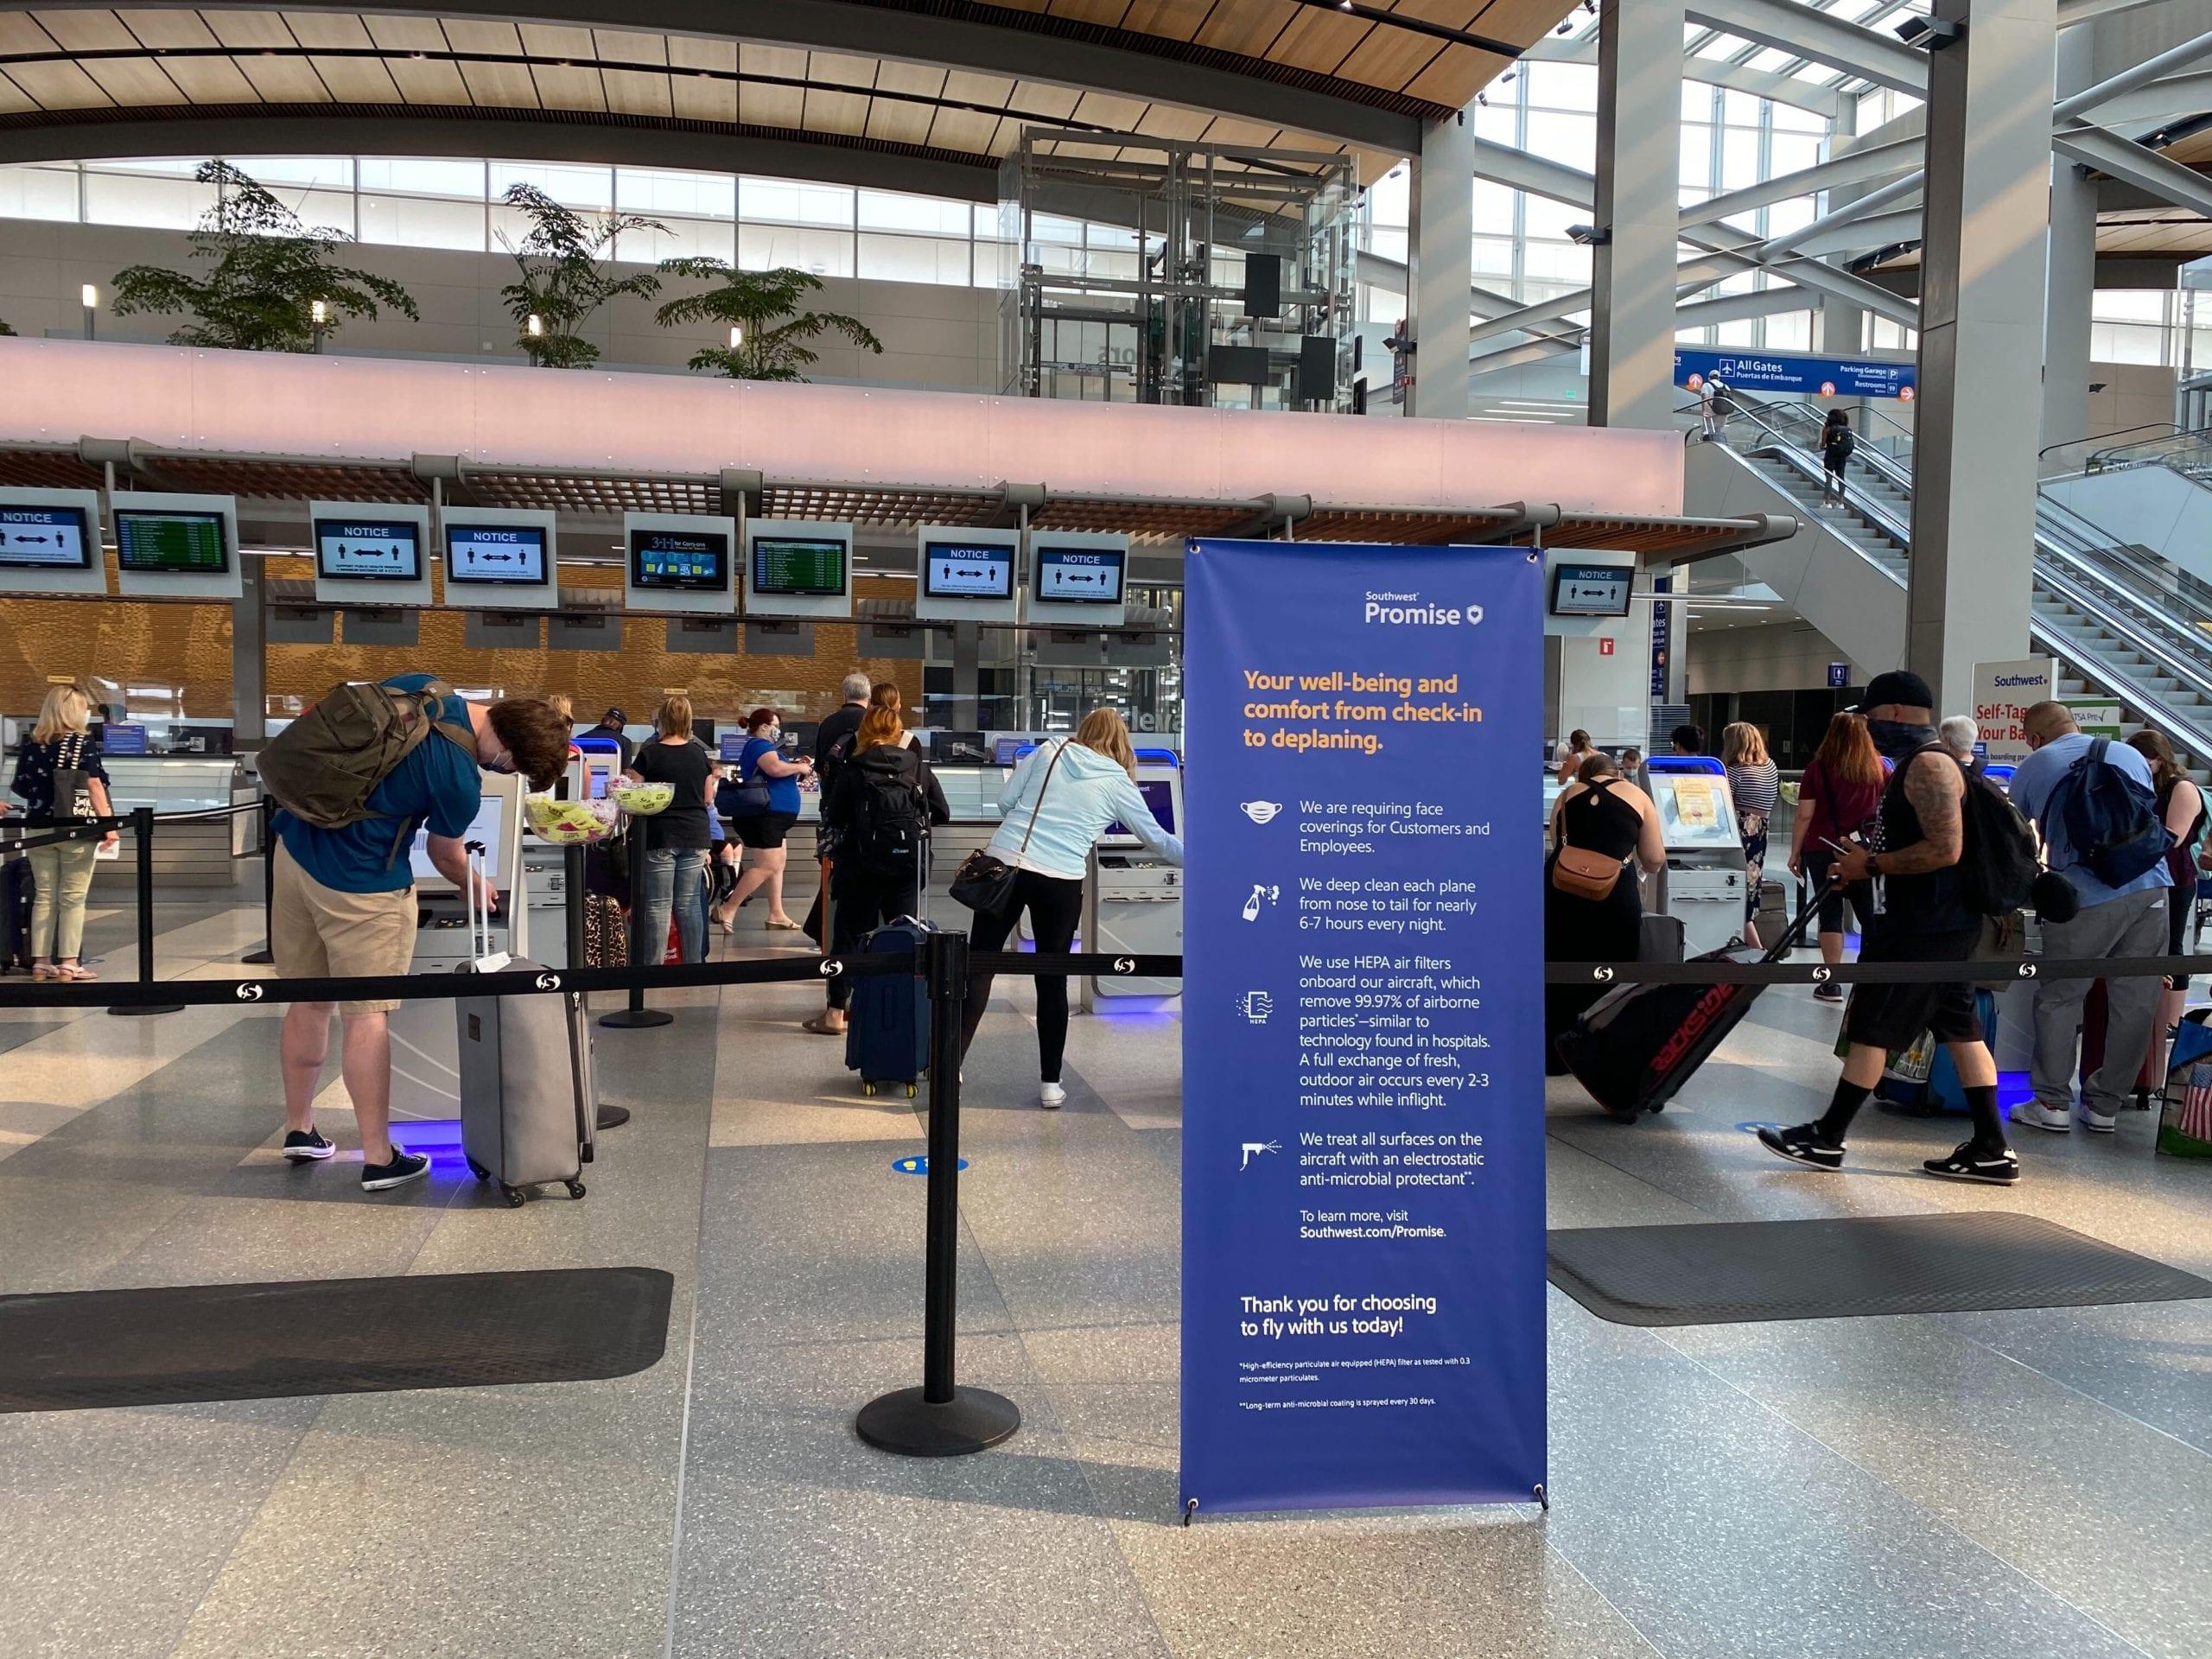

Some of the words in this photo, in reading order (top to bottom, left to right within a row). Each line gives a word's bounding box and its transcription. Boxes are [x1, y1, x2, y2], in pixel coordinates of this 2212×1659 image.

[1737, 360, 1751, 371] All
[1753, 361, 1783, 372] Gates
[1840, 365, 1864, 375] Parking
[1865, 366, 1887, 376] Garage
[1736, 372, 1761, 380] Puertas
[1770, 373, 1803, 383] Embarque
[3, 512, 53, 524] NOTICE
[344, 527, 390, 537] NOTICE
[474, 532, 518, 543] NOTICE
[950, 550, 989, 560] NOTICE
[1063, 555, 1101, 564] NOTICE
[1579, 571, 1613, 580] NOTICE
[1366, 602, 1460, 625] Promise
[1652, 618, 1666, 628] ates
[1244, 671, 1294, 690] Your
[1299, 672, 1411, 698] well-being
[1418, 674, 1457, 693] and
[1994, 674, 2044, 687] Southwest
[1244, 699, 1330, 719] comfort
[1335, 701, 1386, 720] from
[1392, 702, 1482, 721] check-in
[2074, 713, 2086, 721] TSA
[1977, 725, 2005, 741] Your
[2009, 725, 2026, 741] Ba
[1243, 729, 1266, 747] to
[1272, 728, 1382, 754] deplaning.
[1990, 753, 2017, 762] boarding
[1300, 801, 1322, 813] We
[1326, 804, 1347, 813] are
[1352, 802, 1411, 818] requiring
[1416, 802, 1443, 815] face
[1300, 823, 1363, 836] coverings
[1367, 820, 1386, 833] for
[1390, 821, 1461, 835] Customers
[1465, 823, 1489, 835] and
[1300, 839, 1375, 855] Employees.
[1300, 878, 1322, 890] We
[1326, 878, 1360, 894] deep
[1364, 879, 1399, 891] clean
[1403, 879, 1434, 892] each
[1440, 880, 1476, 895] plane
[1300, 897, 1331, 910] from
[1337, 900, 1368, 910] nose
[1372, 899, 1385, 911] to
[1389, 898, 1408, 911] tail
[1413, 898, 1432, 911] for
[1437, 899, 1477, 915] nearly
[1300, 917, 1321, 929] 6-7
[1326, 917, 1363, 930] hours
[1368, 920, 1405, 933] every
[1409, 918, 1446, 934] night.
[1300, 956, 1322, 968] We
[1327, 959, 1350, 968] use
[1355, 956, 1390, 969] HEPA
[1395, 957, 1410, 969] air
[1414, 956, 1451, 969] filters
[1300, 975, 1356, 988] onboard
[1361, 979, 1383, 988] our
[1388, 976, 1436, 990] aircraft,
[1440, 976, 1479, 988] which
[1300, 998, 1351, 1007] remove
[1355, 995, 1402, 1007] 99.97%
[1406, 995, 1421, 1007] of
[1424, 995, 1479, 1008] airborne
[1416, 1016, 1429, 1027] to
[1300, 1033, 1371, 1050] technology
[1376, 1033, 1412, 1046] found
[1418, 1034, 1428, 1046] in
[1433, 1034, 1490, 1051] hospitals.
[1300, 1053, 1310, 1065] A
[1313, 1052, 1332, 1065] full
[1338, 1053, 1402, 1070] exchange
[1407, 1053, 1421, 1066] of
[1424, 1053, 1459, 1068] fresh,
[1300, 1073, 1354, 1085] outdoor
[1358, 1073, 1375, 1086] air
[1379, 1077, 1422, 1086] occurs
[1427, 1077, 1464, 1090] every
[1469, 1074, 1489, 1086] 2-3
[1300, 1094, 1353, 1105] minutes
[1357, 1092, 1393, 1106] while
[1398, 1092, 1446, 1109] inflight.
[1300, 1133, 1322, 1145] We
[1327, 1134, 1357, 1145] treat
[1362, 1132, 1375, 1145] all
[1380, 1132, 1434, 1145] surfaces
[1439, 1136, 1456, 1145] on
[1460, 1132, 1482, 1145] the
[1300, 1152, 1346, 1165] aircraft
[1350, 1152, 1378, 1165] with
[1383, 1155, 1398, 1165] an
[1404, 1152, 1484, 1165] electrostatic
[1300, 1172, 1391, 1185] anti-microbial
[1300, 1211, 1314, 1222] To
[1319, 1210, 1345, 1221] learn
[1351, 1212, 1382, 1223] more,
[1386, 1210, 1408, 1221] visit
[1300, 1224, 1446, 1238] Southwest.com/Promise.
[1241, 1295, 1294, 1313] Thank
[1298, 1300, 1328, 1316] you
[1333, 1294, 1357, 1311] for
[1362, 1294, 1436, 1314] choosing
[1241, 1321, 1258, 1336] to
[1262, 1319, 1284, 1339] fly
[1288, 1318, 1323, 1334] with
[1330, 1321, 1347, 1333] us
[1352, 1317, 1402, 1337] today!
[1295, 1360, 1330, 1370] particulate
[1332, 1358, 1340, 1368] air
[1341, 1359, 1373, 1369] equipped
[1374, 1358, 1397, 1368] (HEPA)
[1398, 1357, 1414, 1366] filter
[1423, 1357, 1443, 1366] tested
[1445, 1357, 1459, 1365] with
[1460, 1357, 1471, 1365] 0.3
[1240, 1375, 1279, 1383] micrometer
[1280, 1373, 1319, 1383] particulates.
[1283, 1399, 1329, 1408] anti-microbial
[1330, 1399, 1355, 1408] coating
[1356, 1397, 1362, 1407] is
[1363, 1398, 1389, 1408] sprayed
[1410, 1396, 1419, 1405] 30
[1420, 1396, 1436, 1407] days.
